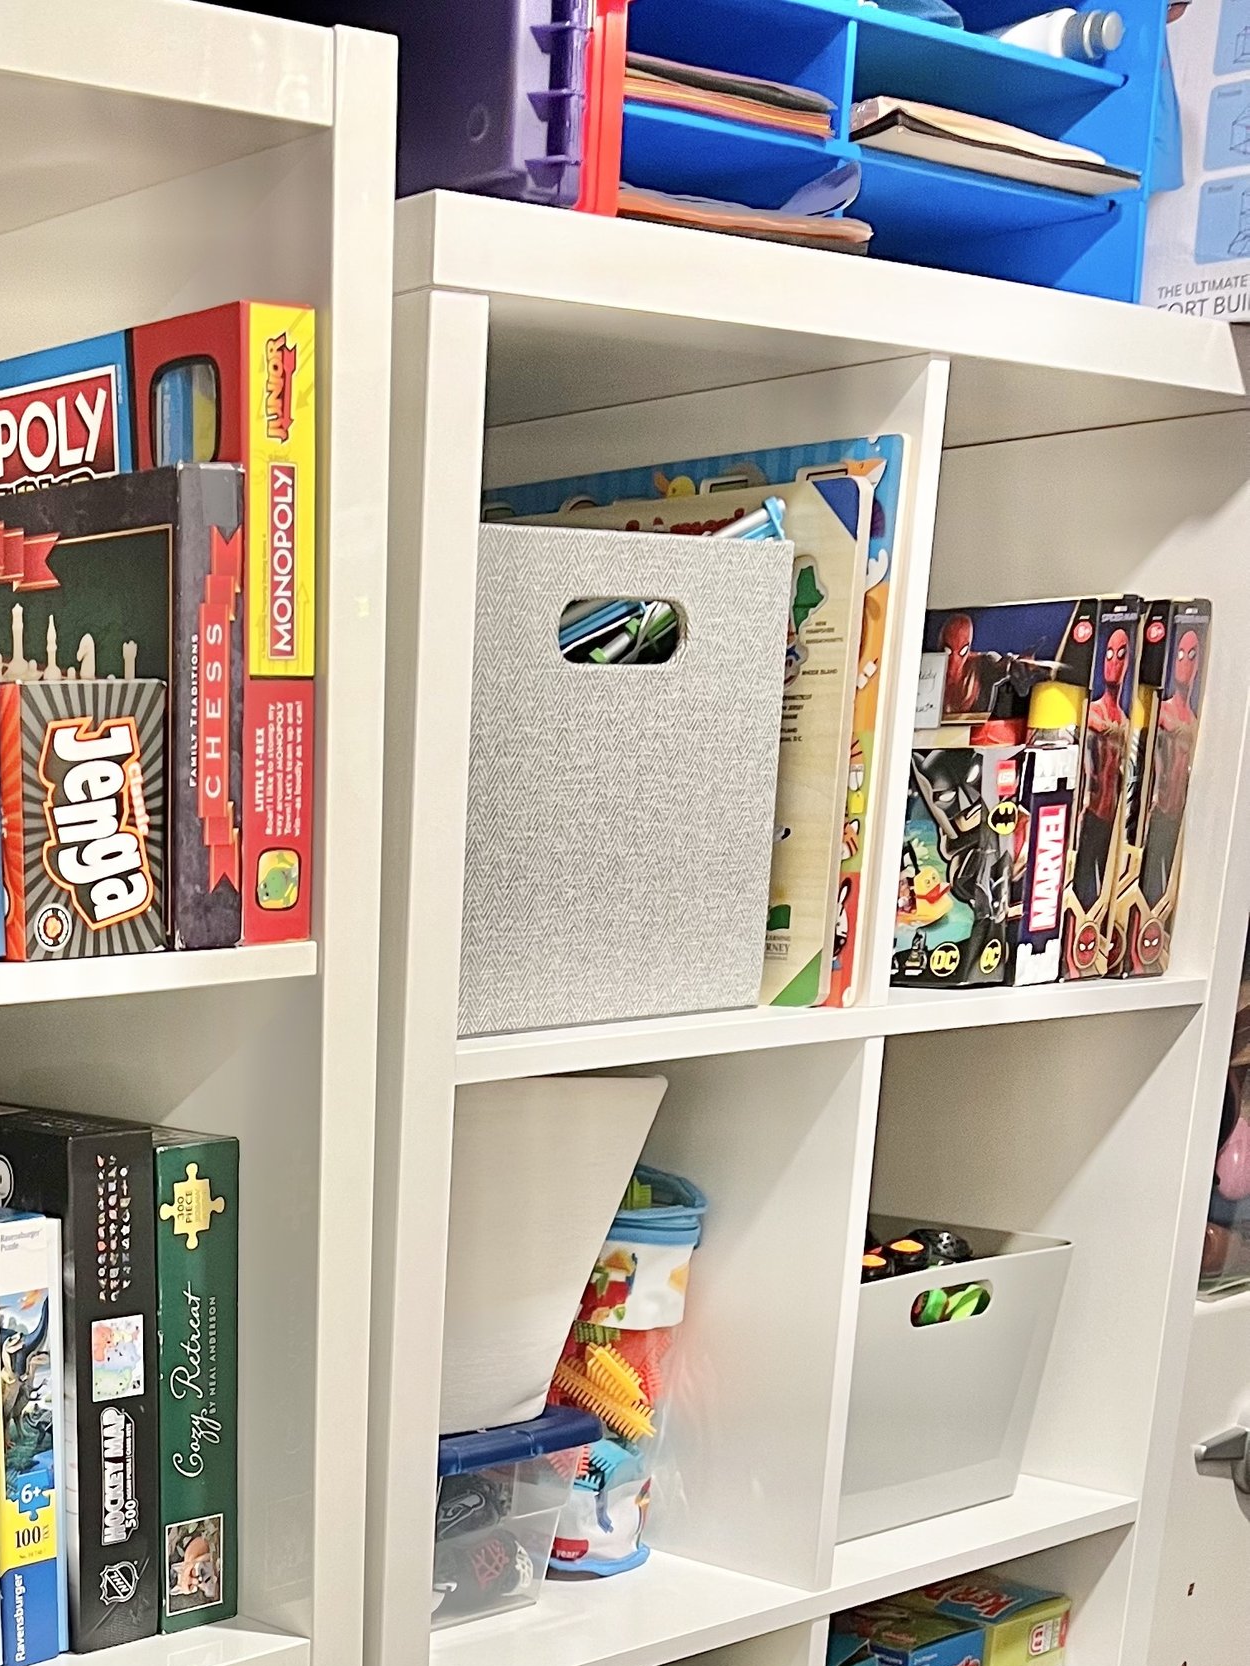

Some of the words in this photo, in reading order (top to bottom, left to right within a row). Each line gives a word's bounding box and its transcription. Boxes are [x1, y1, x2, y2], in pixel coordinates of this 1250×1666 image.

[1158, 283, 1182, 299] THE
[1185, 274, 1247, 296] ULTIMATE
[266, 333, 297, 444] JUNIOR
[273, 468, 293, 652] MONOPOLY
[190, 633, 199, 740] TRADITIONS
[205, 622, 223, 799] CHESS
[189, 743, 198, 787] FAMILY
[255, 728, 264, 766] T-REX
[255, 770, 264, 812] LITTLE
[53, 726, 147, 922] Jenga
[1030, 811, 1065, 929] MARVEL
[932, 947, 959, 973] DC
[982, 941, 1000, 971] DC
[171, 1281, 204, 1399] Retreat
[208, 1296, 217, 1365] ANDERSON
[102, 1408, 126, 1458] MAP
[210, 1400, 217, 1413] BY
[173, 1408, 222, 1478] Cozy
[20, 1482, 42, 1504] 6+
[104, 1461, 127, 1544] HOCKEY
[125, 1500, 137, 1529] 500
[110, 1569, 131, 1595] NHL
[15, 1573, 24, 1662] Ravensburger
